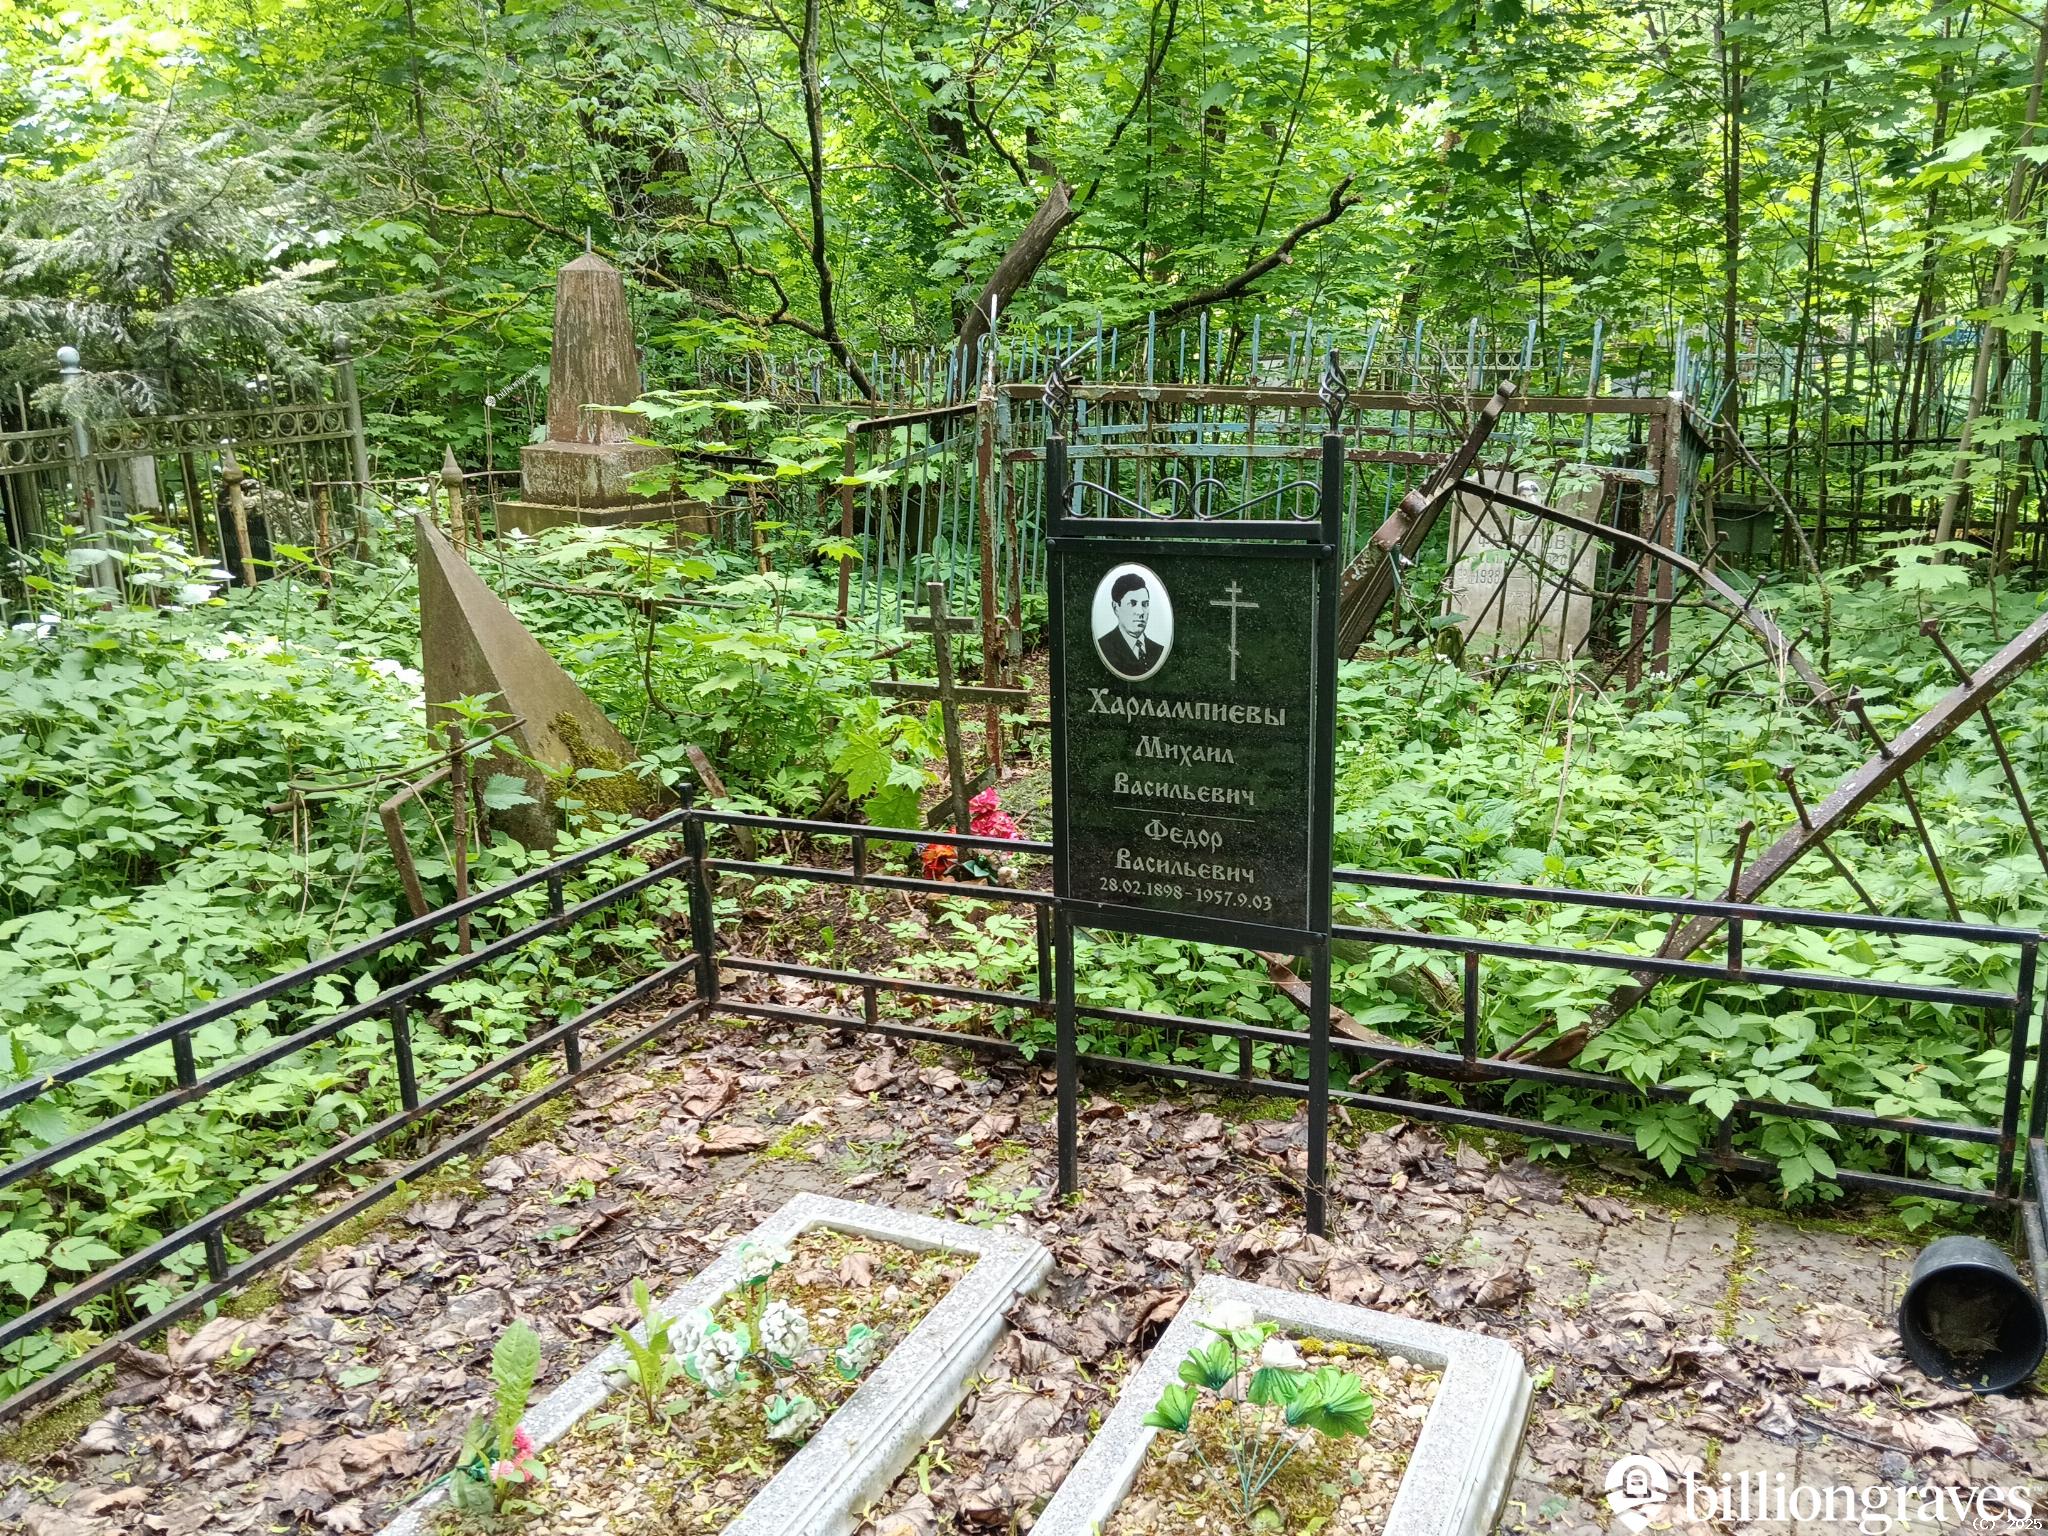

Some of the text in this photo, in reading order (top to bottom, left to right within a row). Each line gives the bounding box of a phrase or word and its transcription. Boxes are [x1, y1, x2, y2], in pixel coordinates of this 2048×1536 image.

[1087, 687, 1286, 726] Харлампиевы
[1135, 735, 1236, 768] Михаил
[1112, 772, 1256, 806] Васильевич
[1144, 819, 1224, 854] Федор
[1114, 847, 1256, 884] Васильевич
